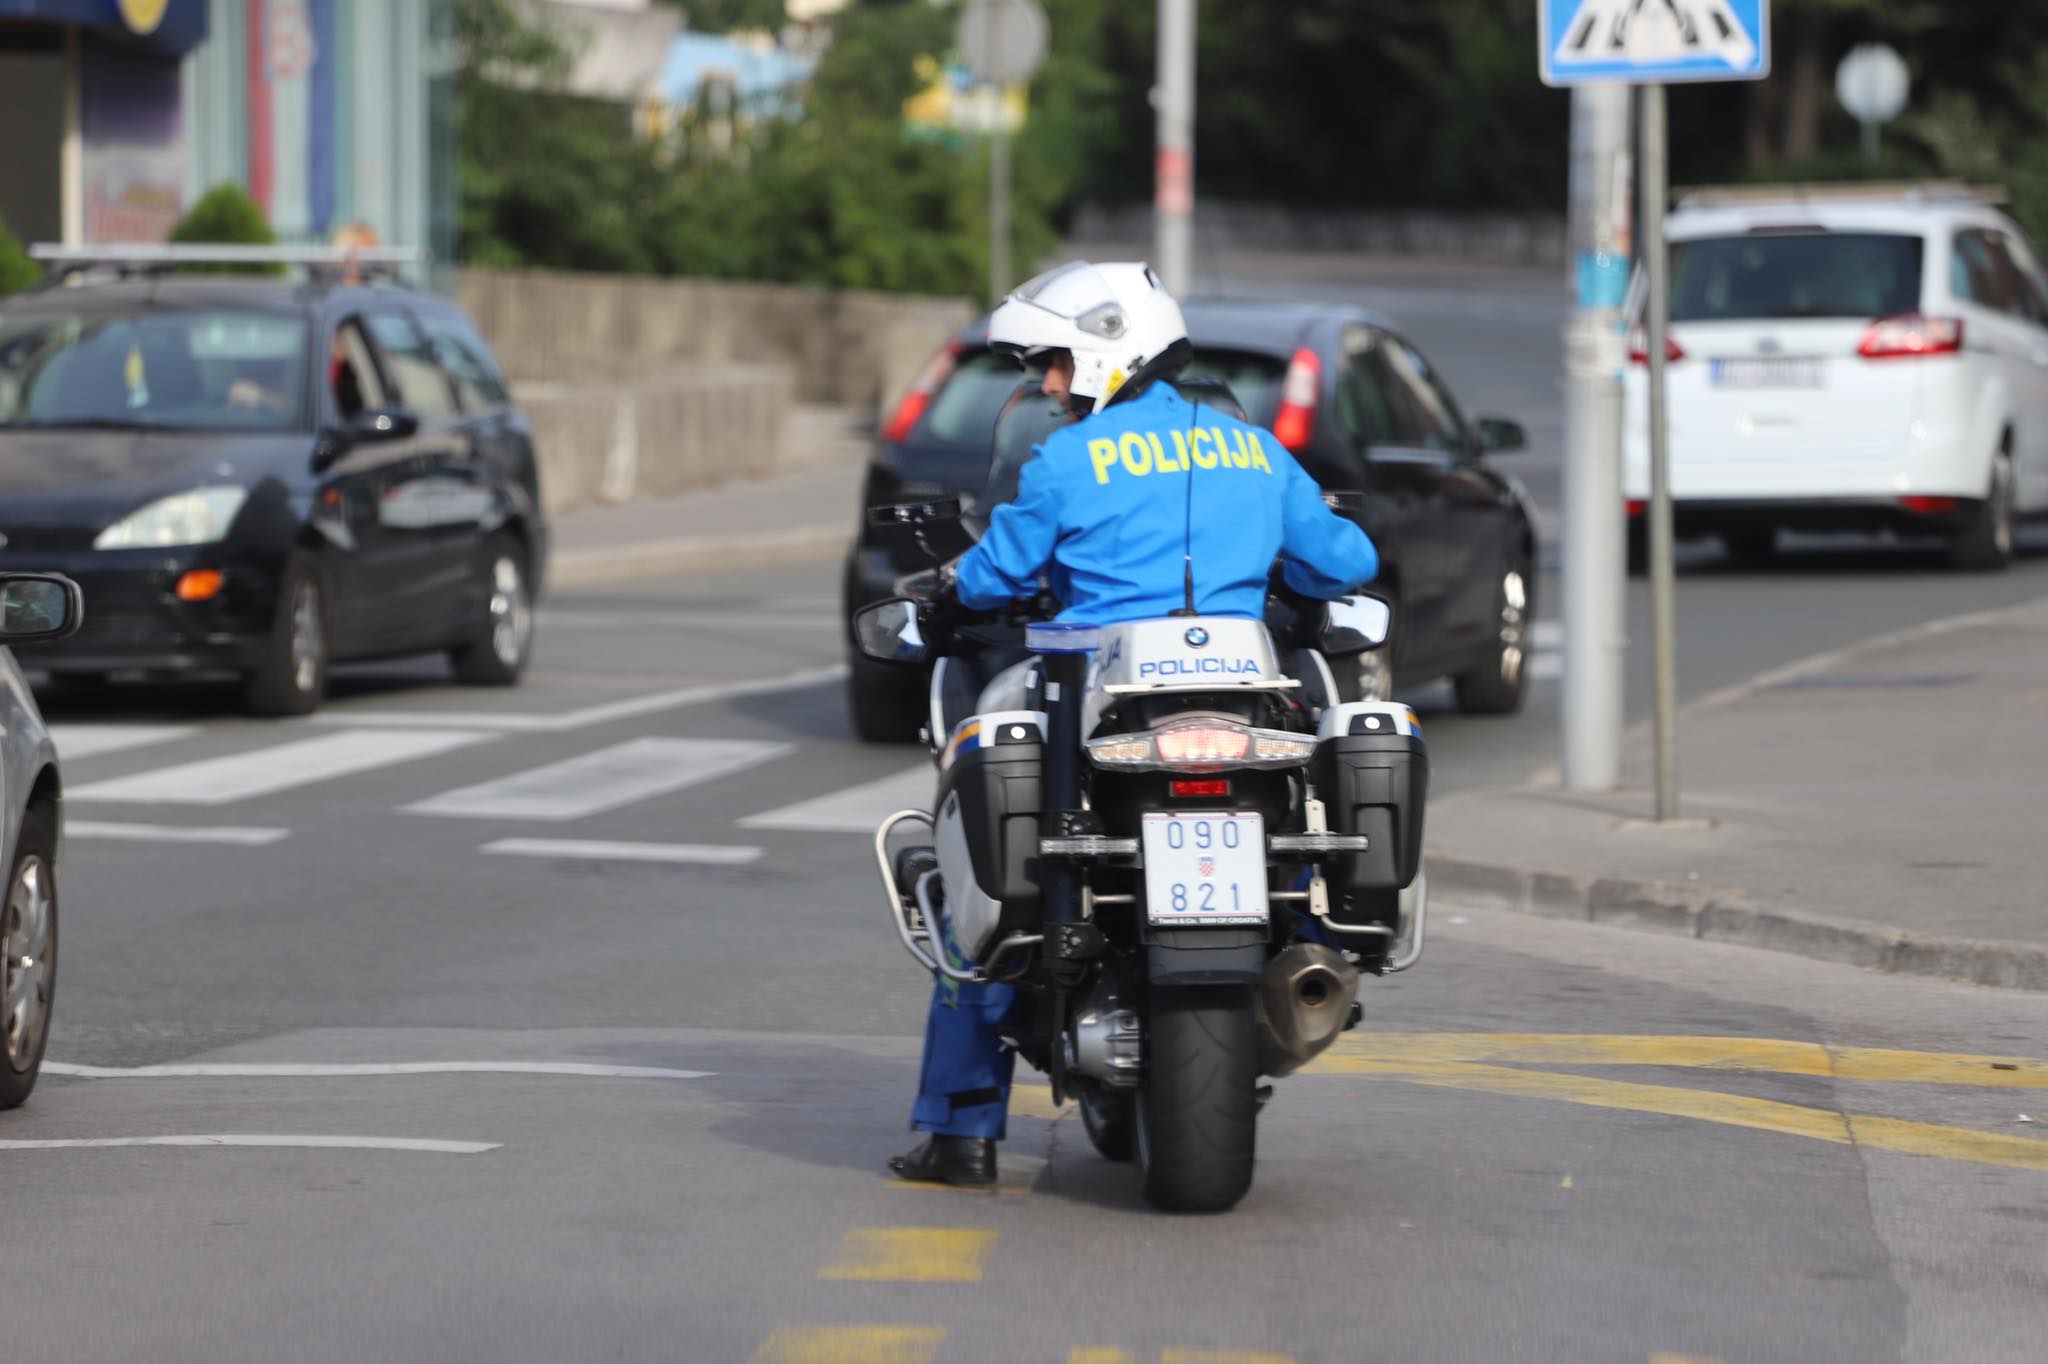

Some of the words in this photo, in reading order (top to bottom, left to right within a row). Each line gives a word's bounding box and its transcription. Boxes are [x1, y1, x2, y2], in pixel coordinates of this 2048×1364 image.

[1087, 426, 1273, 485] POLICIJA
[1139, 657, 1261, 678] POLICIJA
[1167, 820, 1239, 849] 090
[1170, 882, 1239, 912] 821
